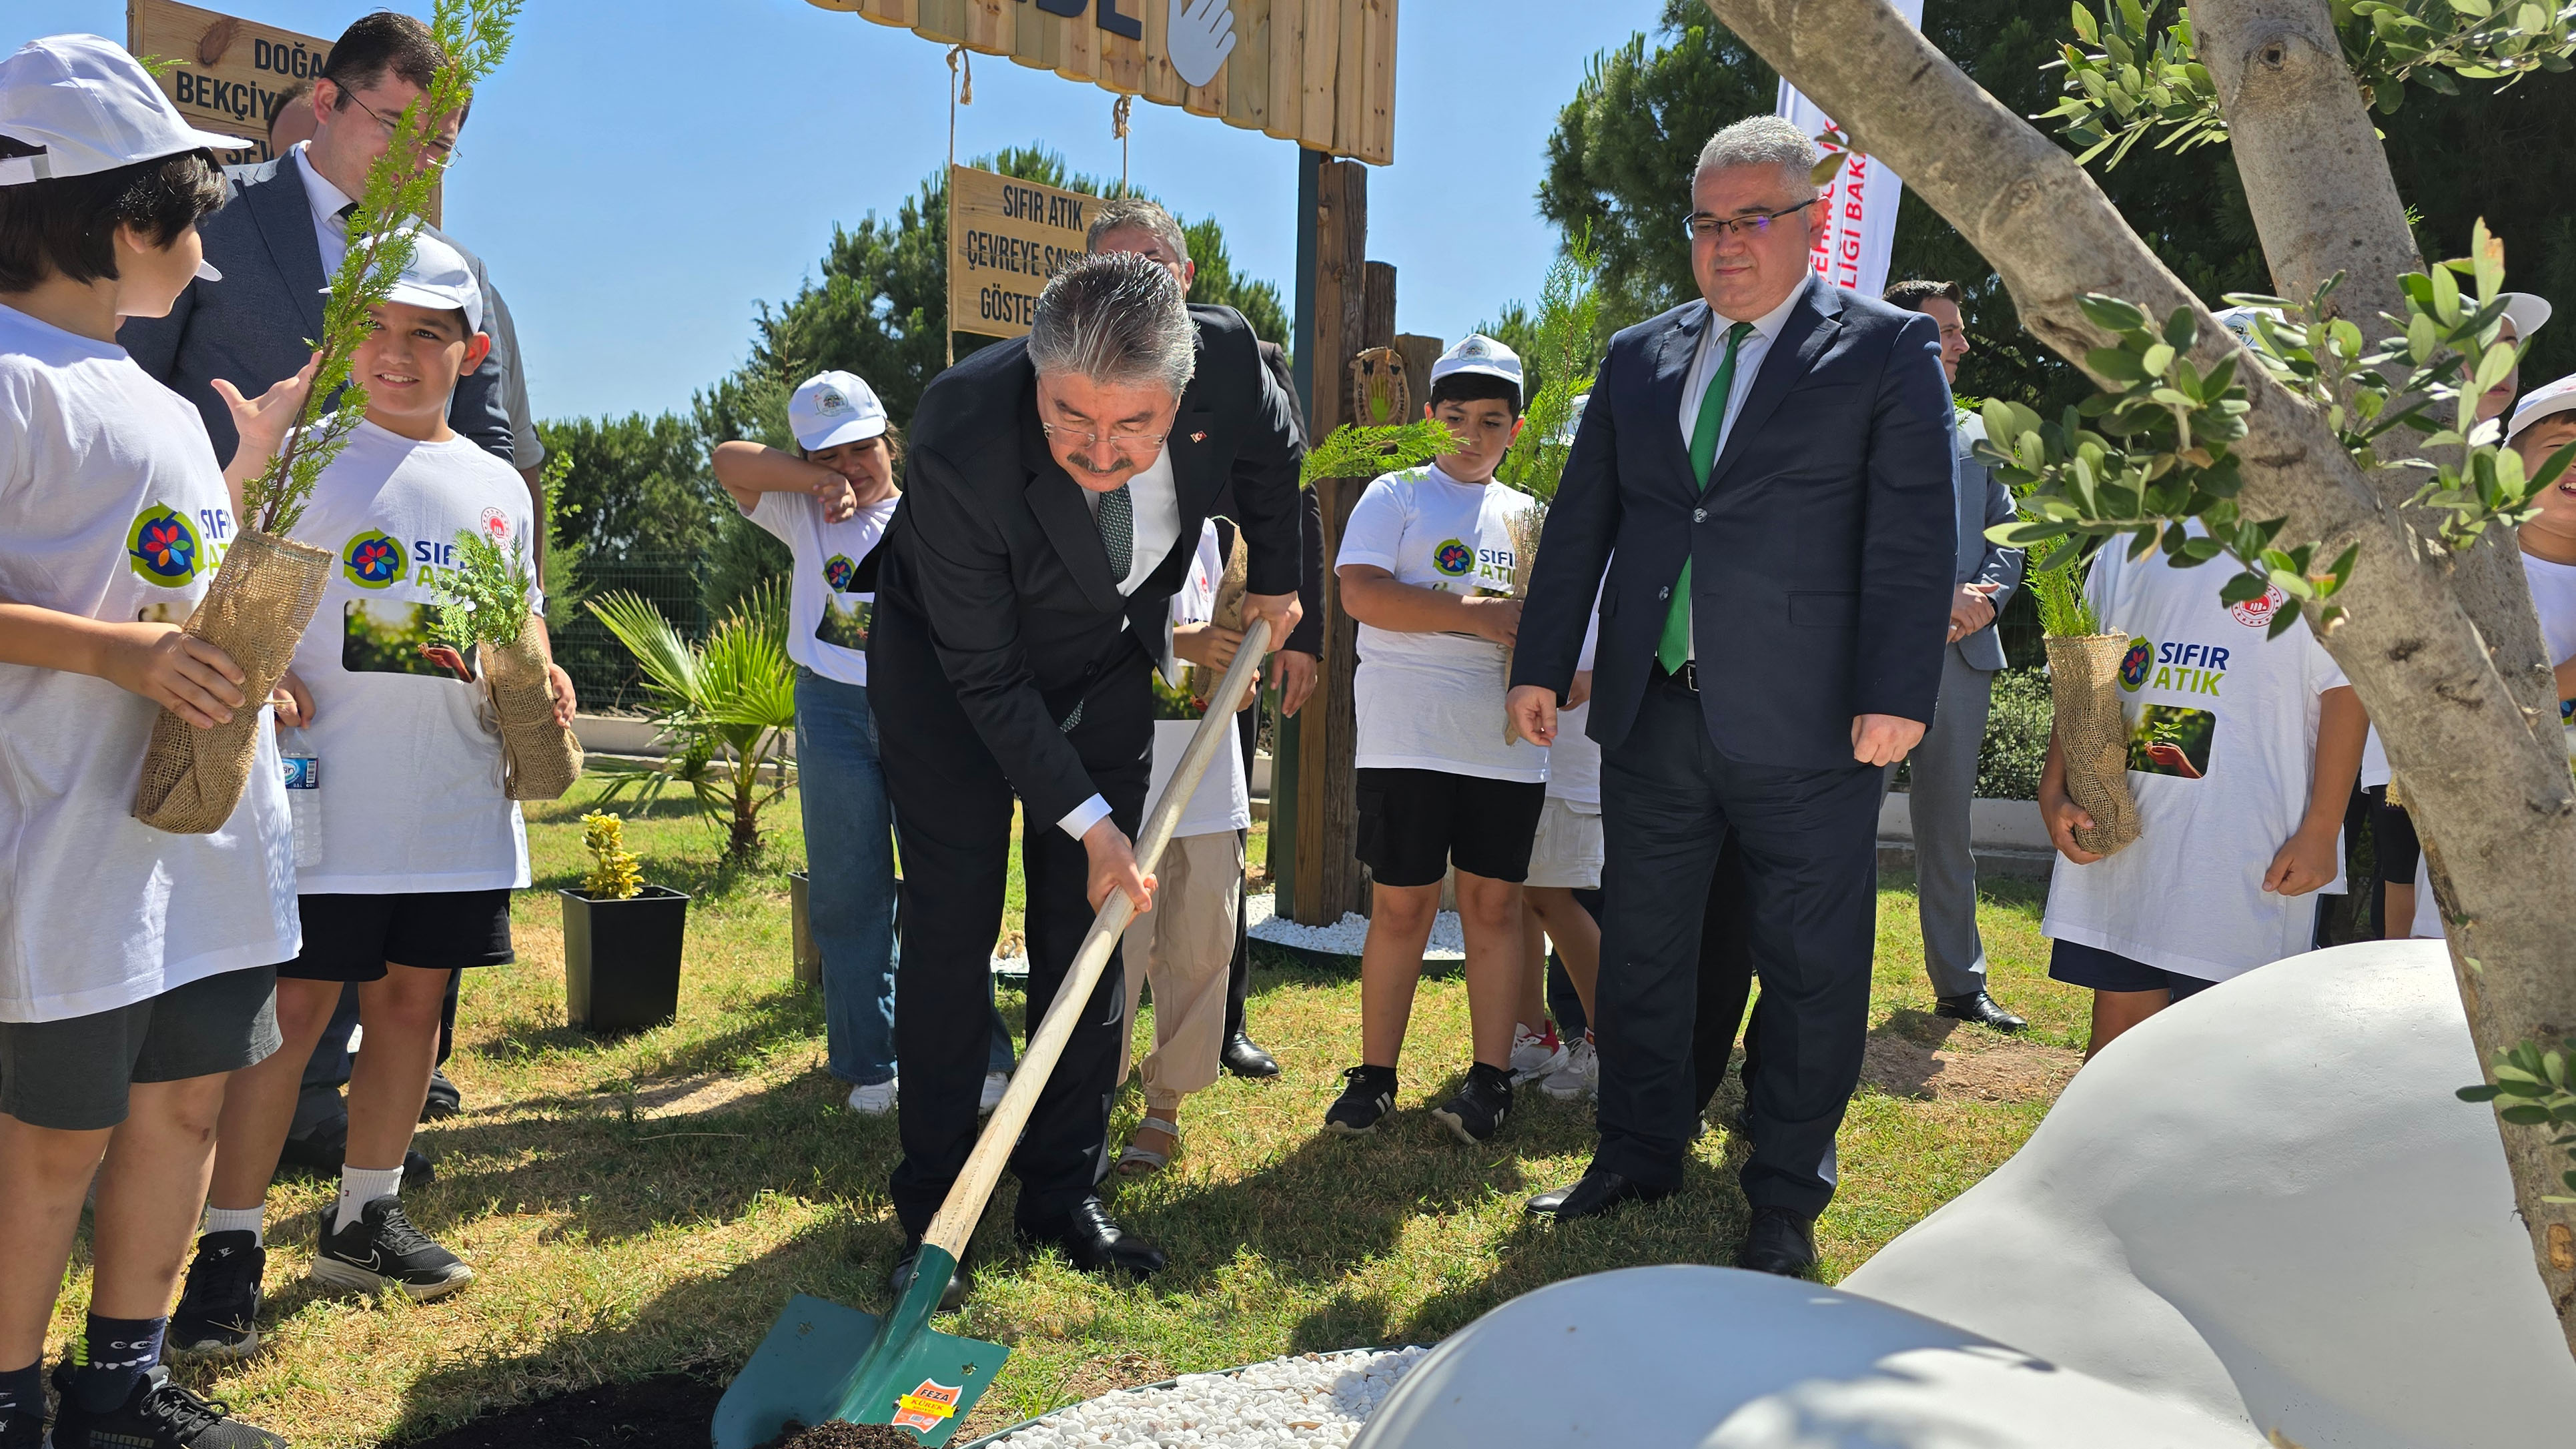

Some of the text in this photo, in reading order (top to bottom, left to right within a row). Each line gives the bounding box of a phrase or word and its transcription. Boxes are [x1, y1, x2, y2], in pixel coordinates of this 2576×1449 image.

[1845, 153, 1866, 221] BAK
[1003, 185, 1084, 231] SIFIR ATIK
[967, 230, 1040, 276] ÇEVREYE
[981, 283, 1039, 326] GÖSTE
[1479, 549, 1517, 567] SIFI
[2158, 642, 2229, 670] SIFIR
[2152, 667, 2225, 696] ATIK
[920, 1389, 949, 1402] FEZA
